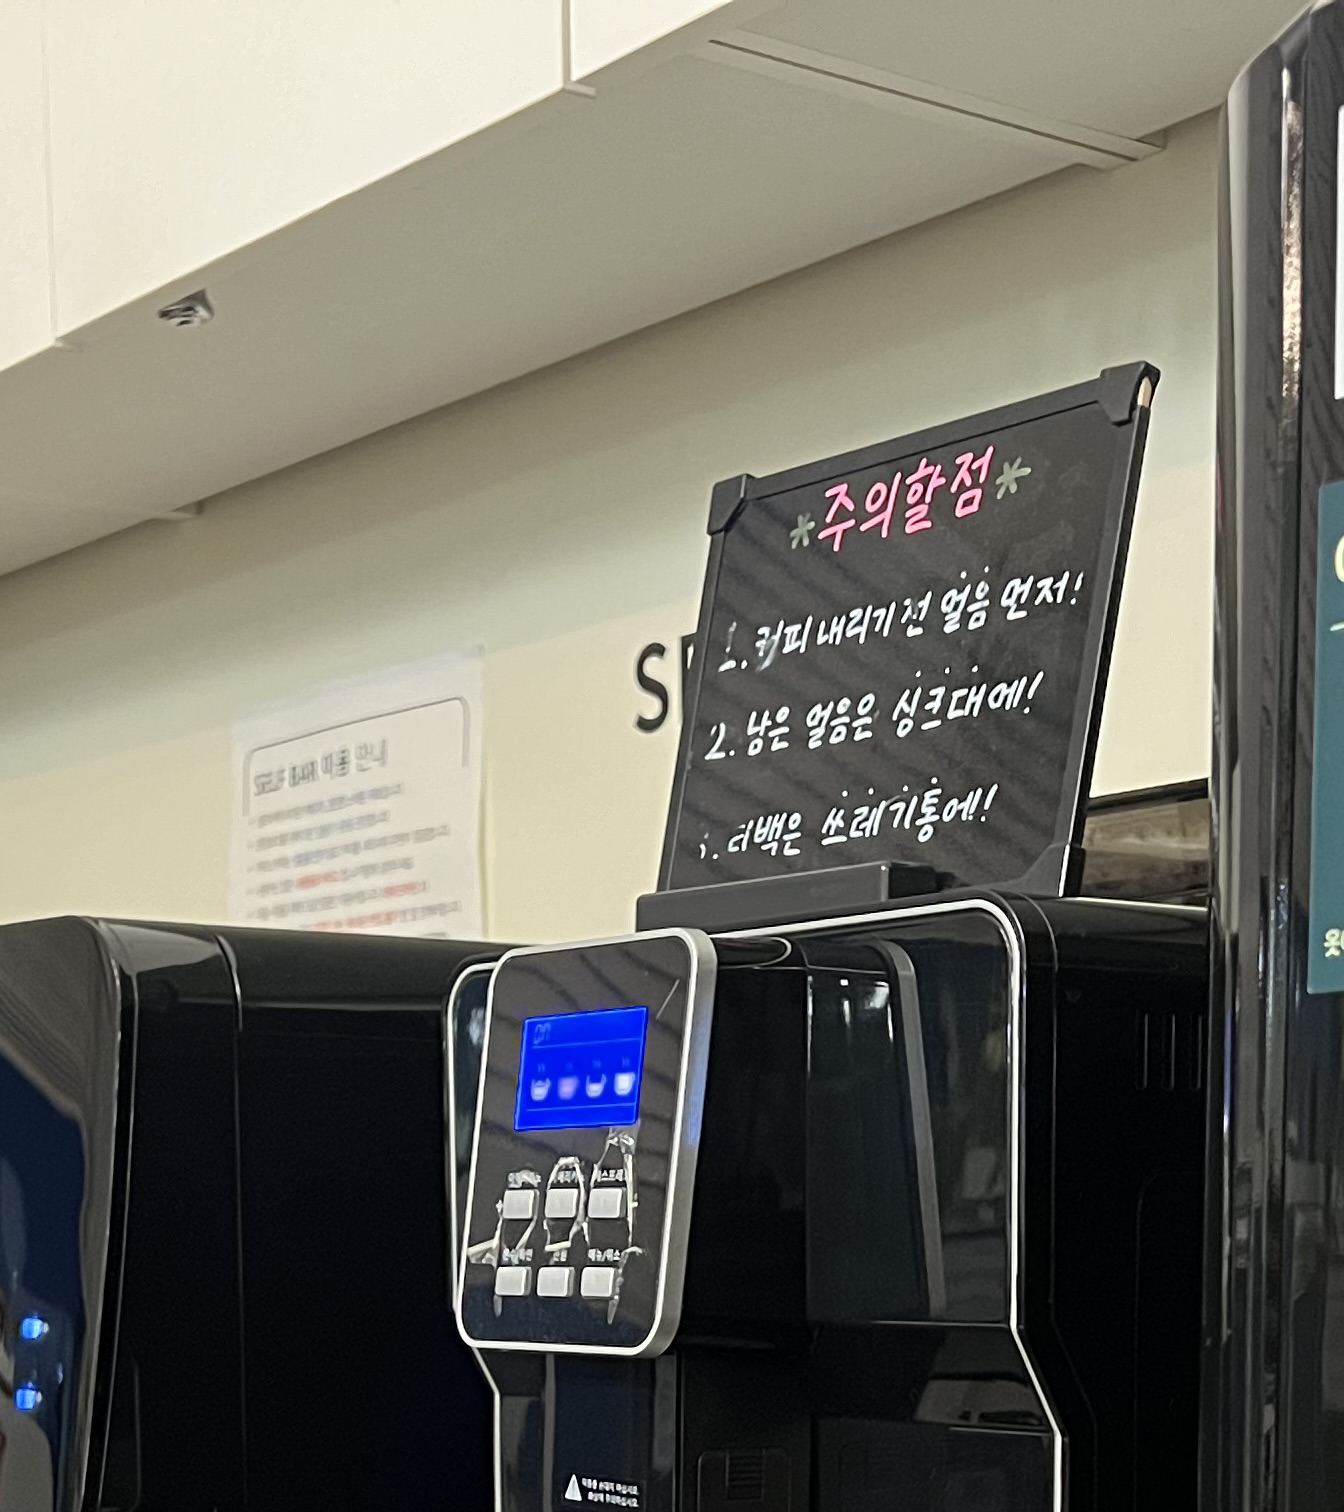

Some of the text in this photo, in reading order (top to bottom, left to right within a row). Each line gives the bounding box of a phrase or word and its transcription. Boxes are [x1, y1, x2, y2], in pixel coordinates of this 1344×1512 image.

[818, 446, 994, 551] 주의할점
[940, 582, 991, 634] 얼음
[999, 571, 1085, 622] 먼저!
[704, 671, 1045, 761] 2. 남은 얼음은 싱크대에!
